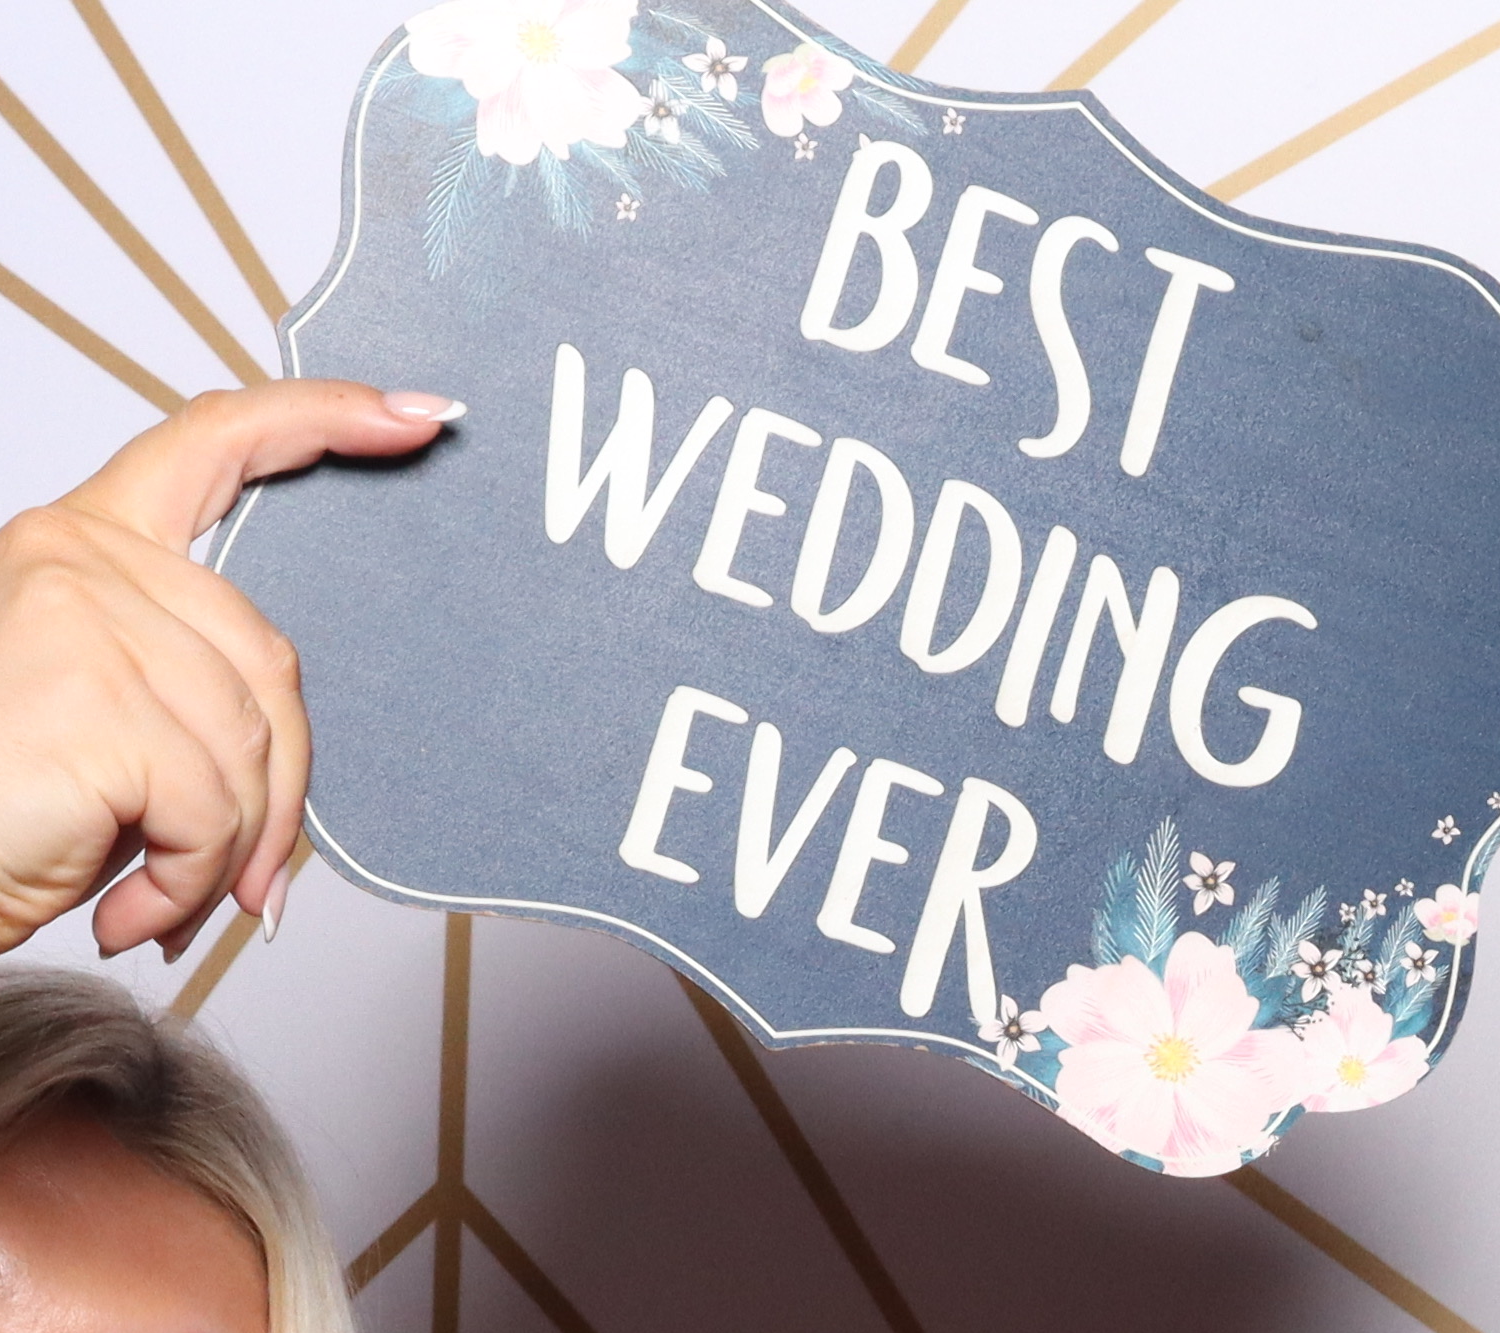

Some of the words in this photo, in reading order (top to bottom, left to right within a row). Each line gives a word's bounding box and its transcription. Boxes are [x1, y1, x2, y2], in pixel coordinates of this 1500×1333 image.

[799, 139, 1236, 478] BEST
[543, 342, 1318, 787] WEDDING
[618, 685, 1038, 1024] EVER
